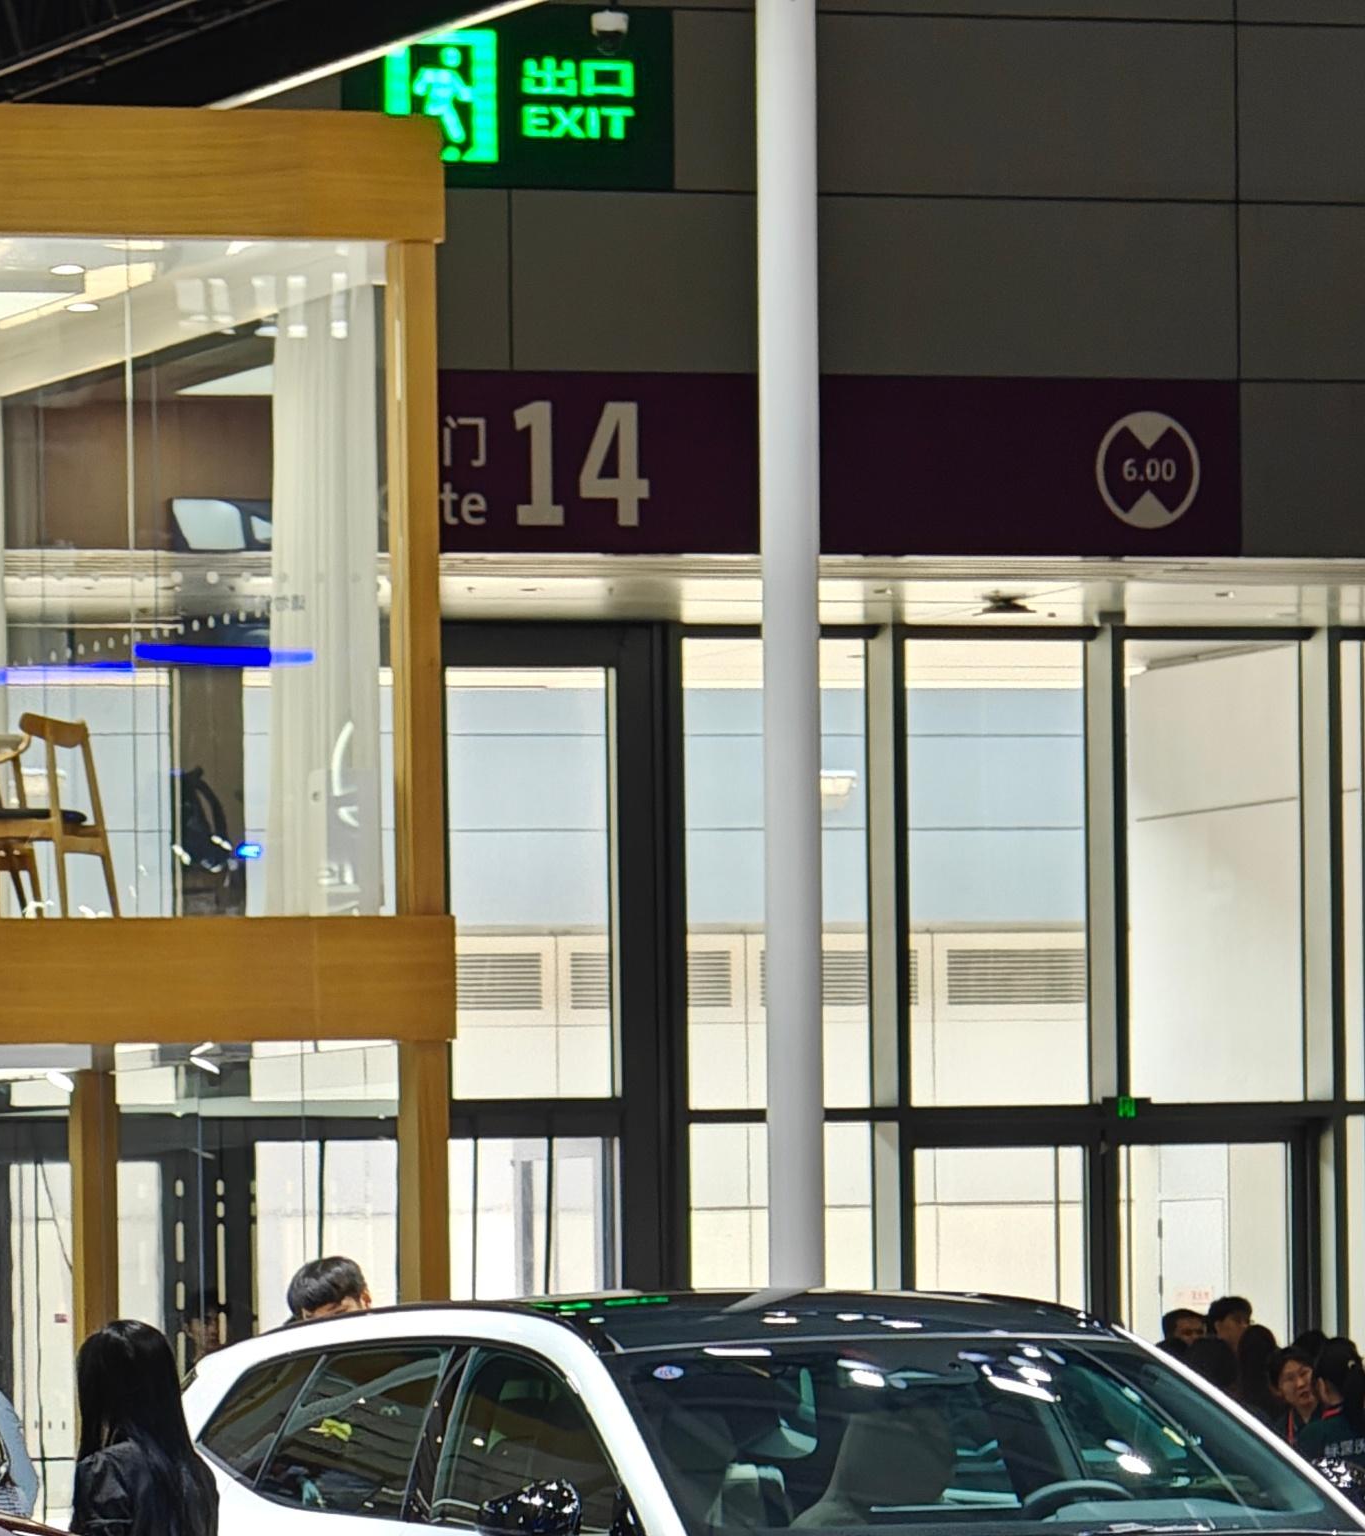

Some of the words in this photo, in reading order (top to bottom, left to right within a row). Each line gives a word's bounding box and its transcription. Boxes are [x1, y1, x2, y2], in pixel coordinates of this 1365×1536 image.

[521, 56, 635, 98] 出口
[521, 104, 636, 139] EXIT
[442, 415, 487, 467] 门
[513, 400, 650, 526] 14
[1122, 458, 1177, 482] 6.00
[439, 481, 488, 525] te
